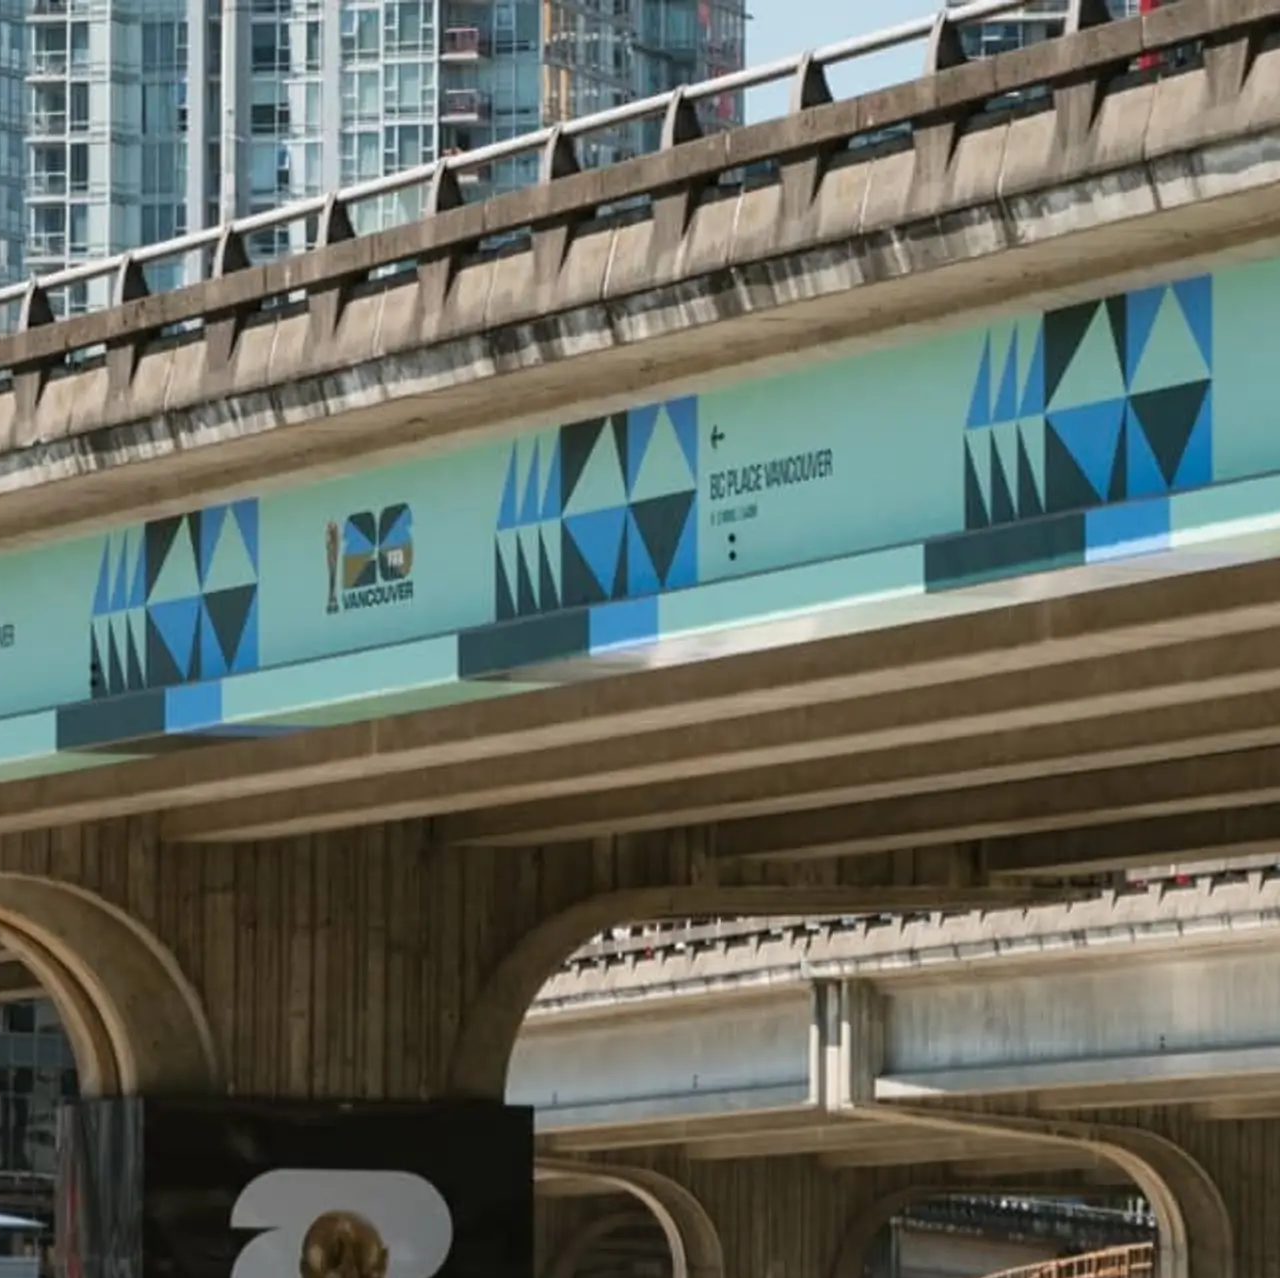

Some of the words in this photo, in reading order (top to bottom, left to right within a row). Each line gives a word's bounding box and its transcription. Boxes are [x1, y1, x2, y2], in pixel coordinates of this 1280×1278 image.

[727, 464, 762, 495] PLACE
[764, 448, 833, 488] VANCOUVER
[342, 580, 413, 610] VANCOUVER
